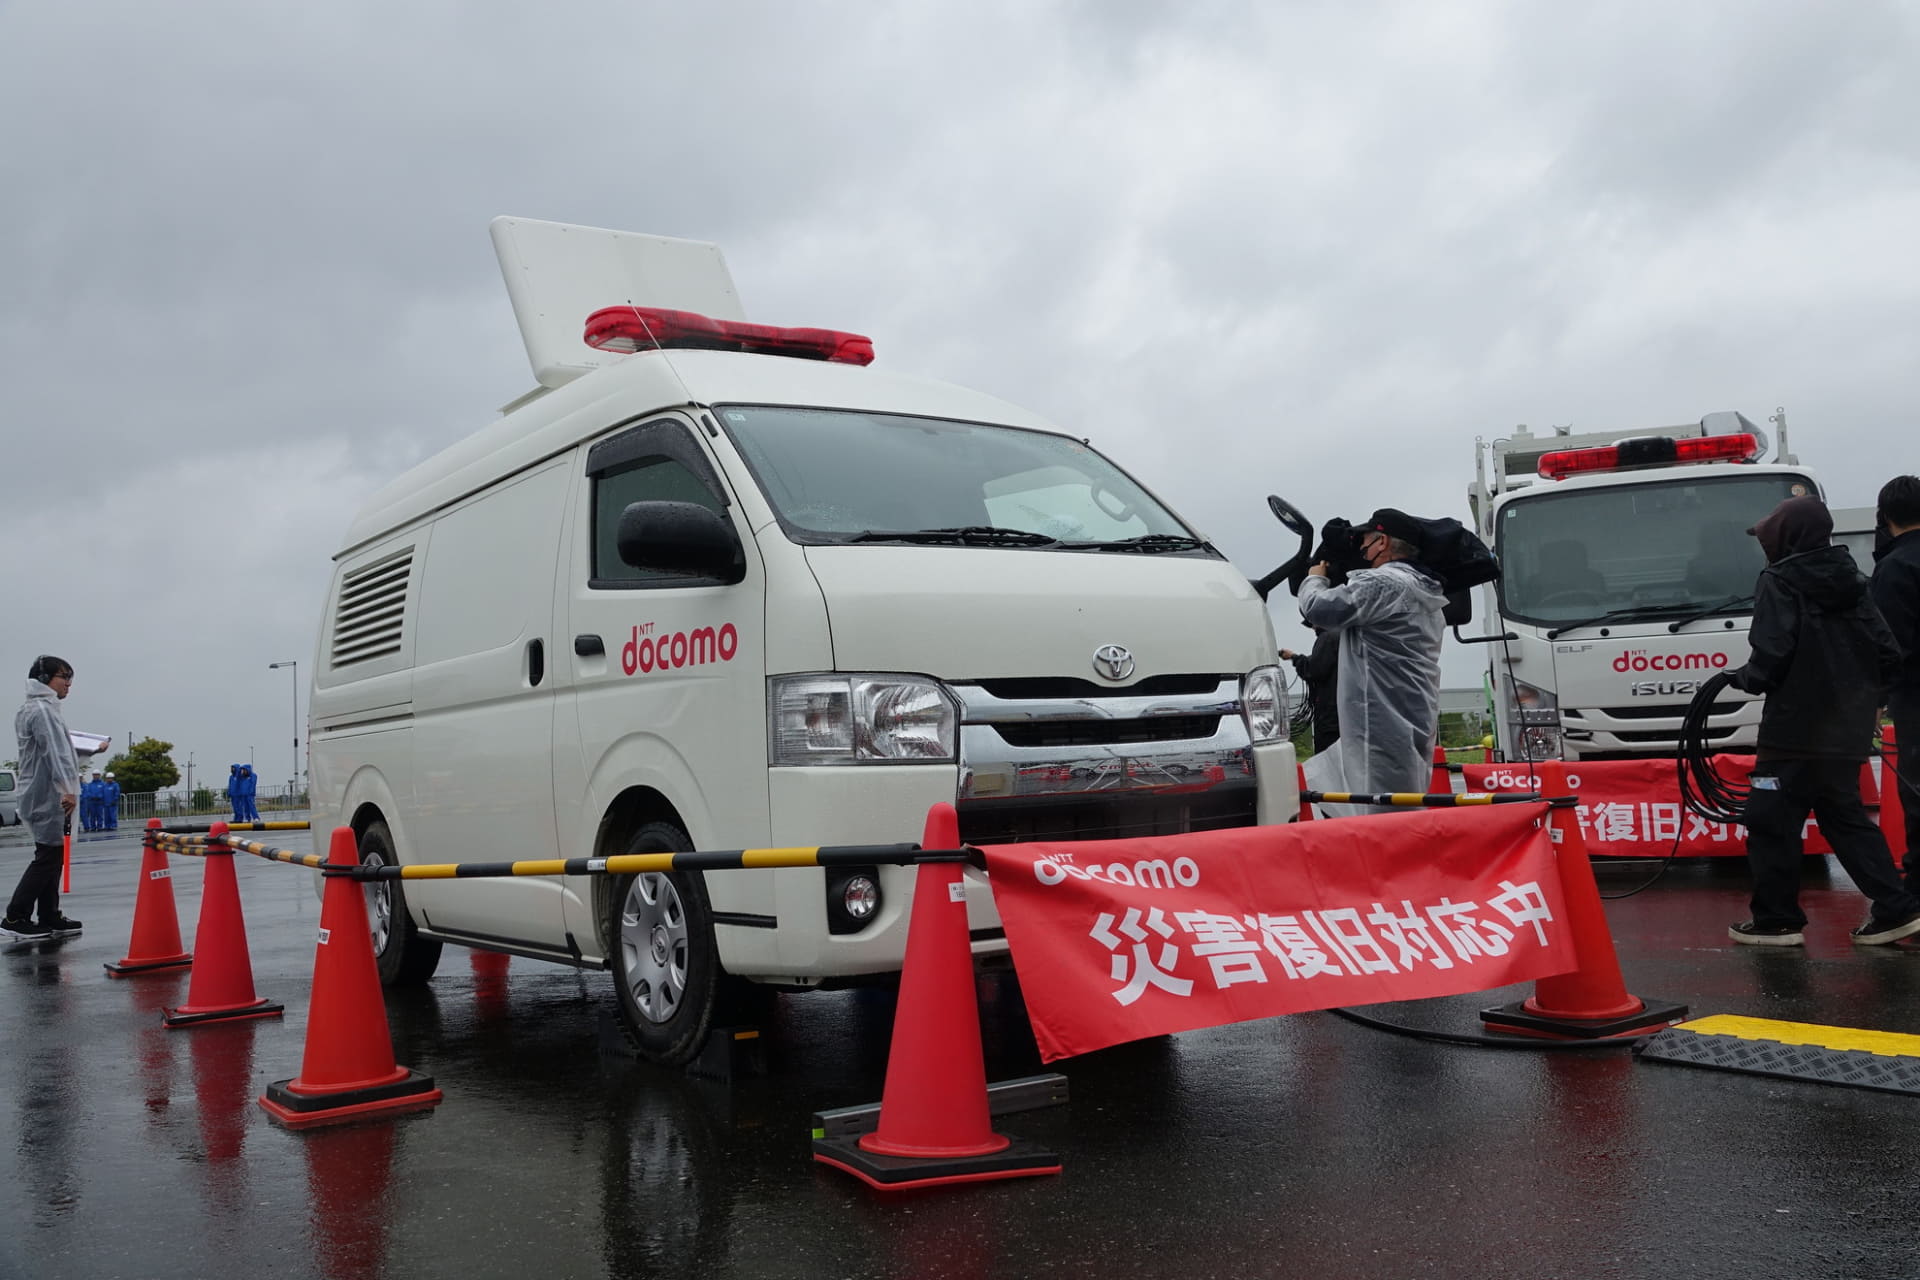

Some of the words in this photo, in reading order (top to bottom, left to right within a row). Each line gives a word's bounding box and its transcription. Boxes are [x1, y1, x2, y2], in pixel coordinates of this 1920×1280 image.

[640, 622, 655, 635] NTT
[622, 623, 738, 676] docomo
[1557, 645, 1592, 653] ELF
[1613, 650, 1728, 672] docomo
[1632, 680, 1701, 696] ISUZ
[1483, 771, 1581, 790] docoo
[1047, 853, 1073, 864] NTT
[1033, 854, 1200, 889] docomo
[1089, 879, 1554, 1007] 災害復旧対応中
